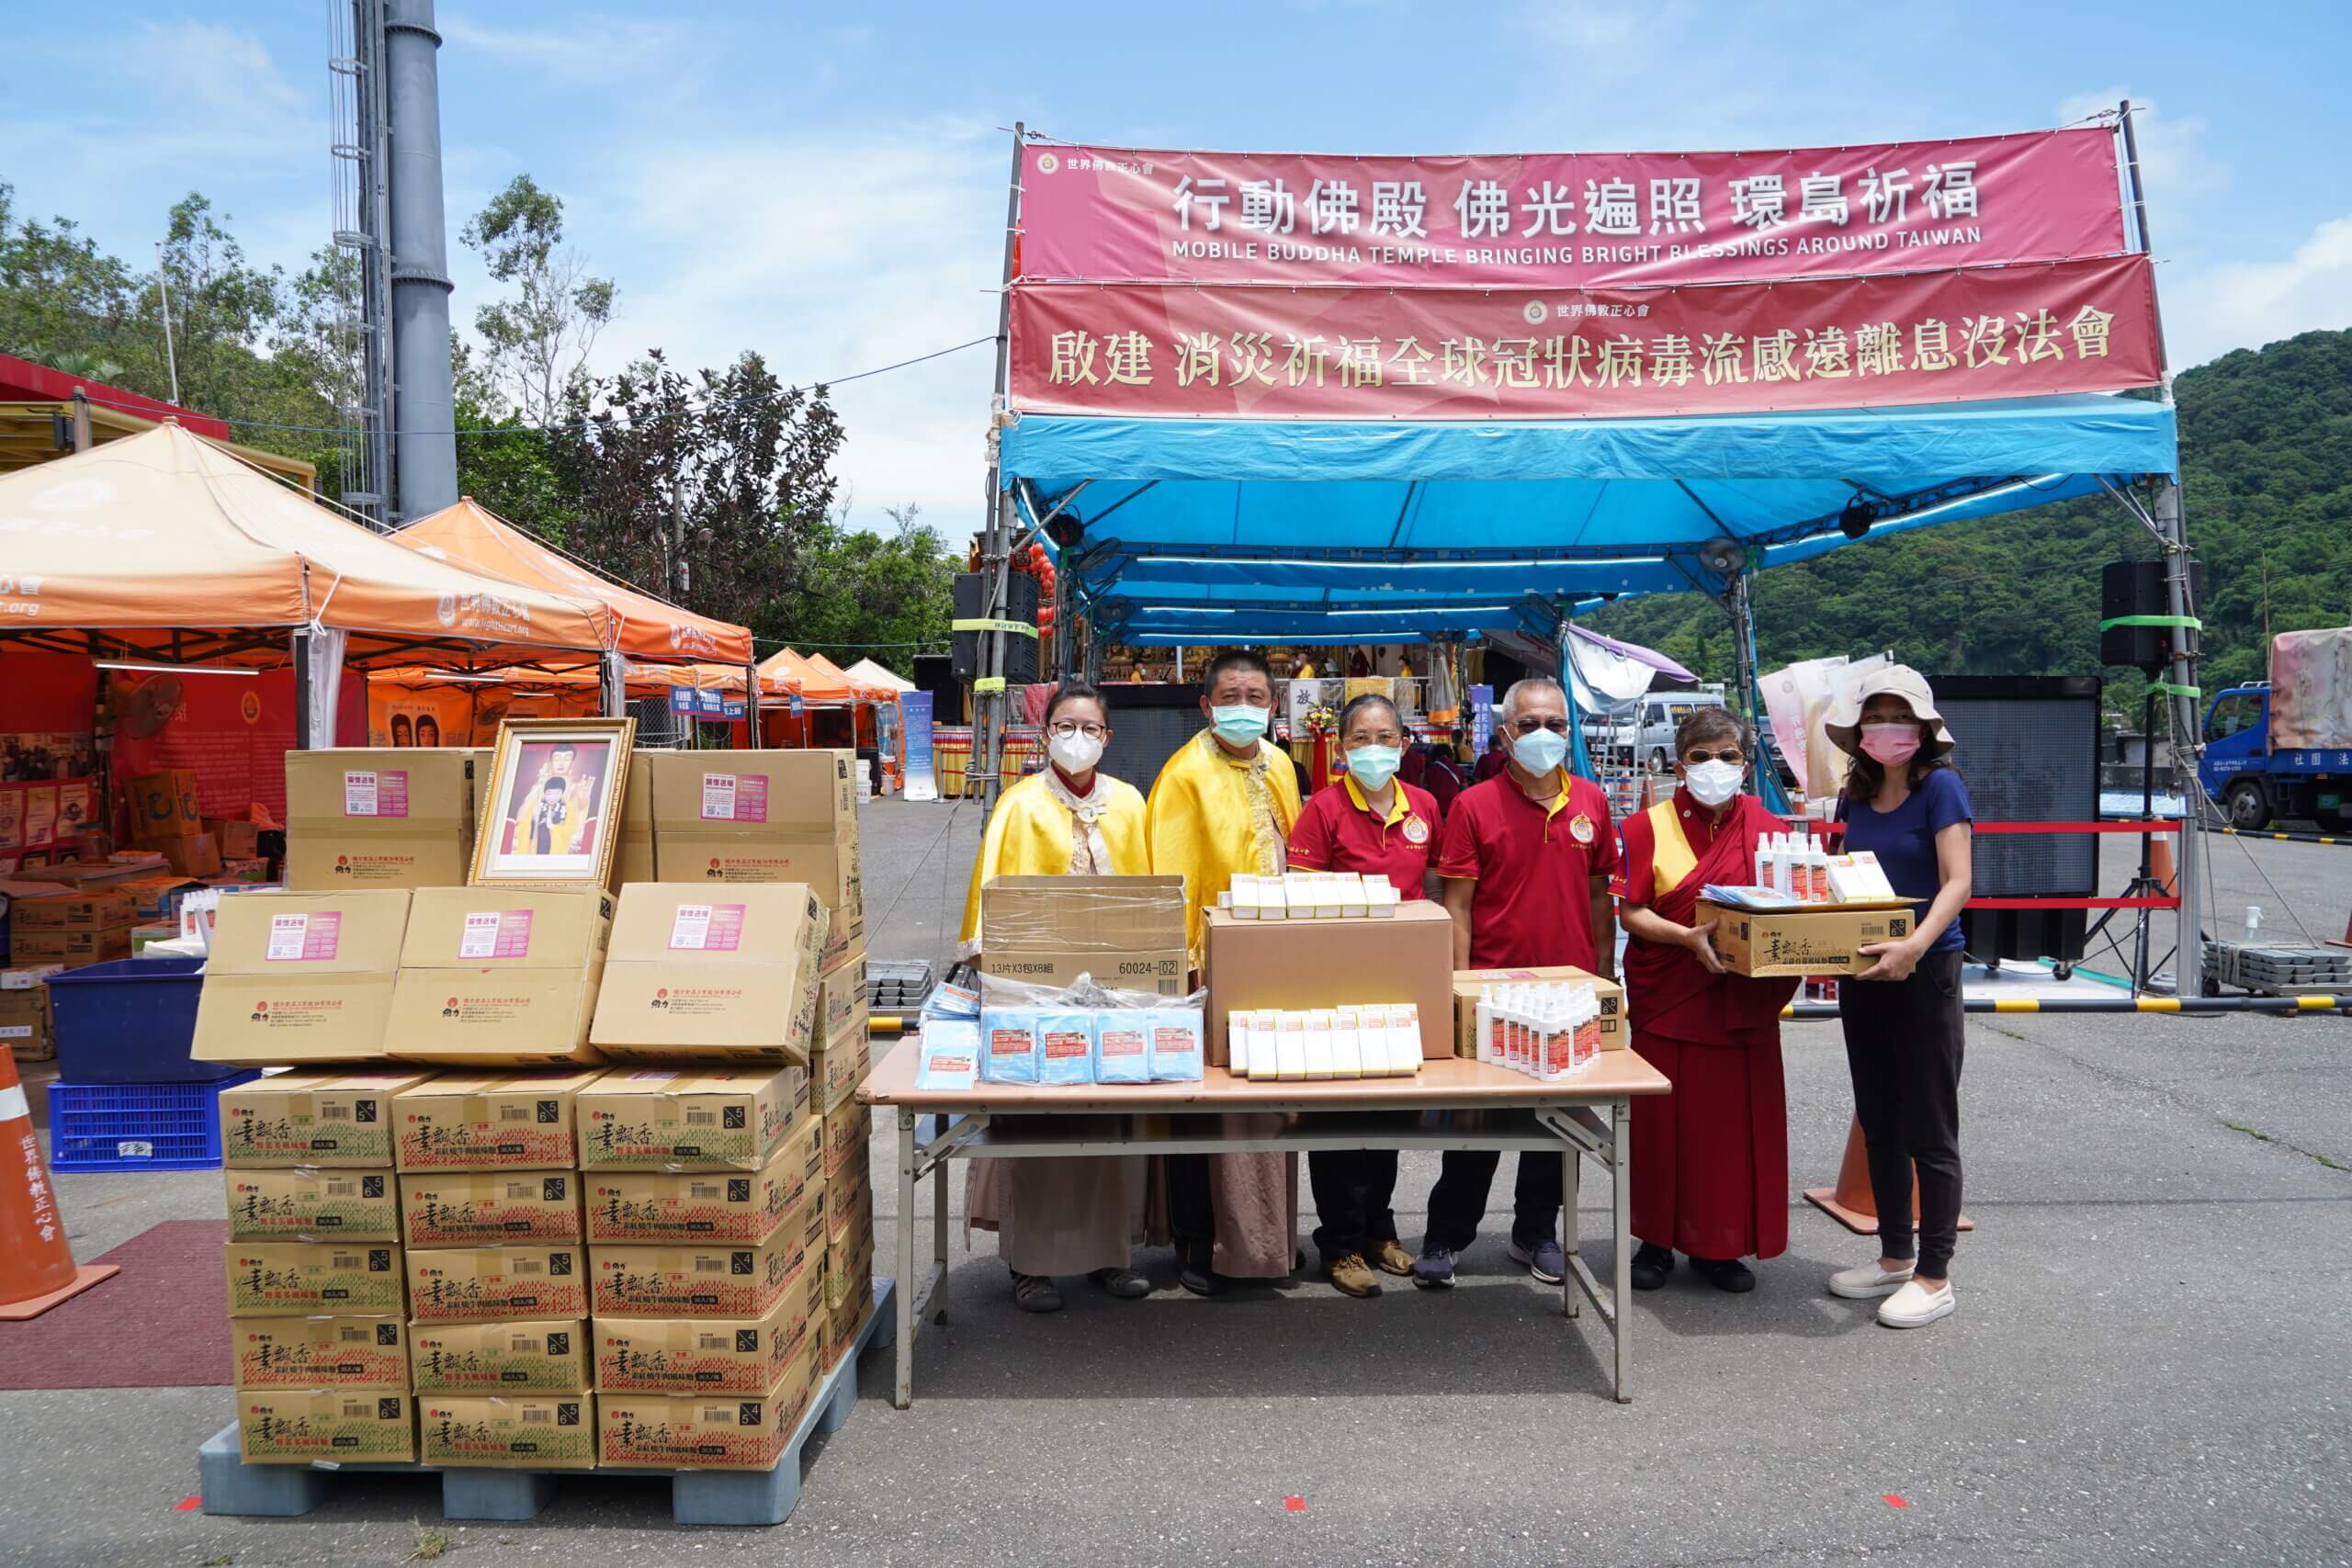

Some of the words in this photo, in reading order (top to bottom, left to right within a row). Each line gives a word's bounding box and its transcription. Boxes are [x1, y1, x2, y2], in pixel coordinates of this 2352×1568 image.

[1172, 175, 1427, 239] 行動佛殿
[1453, 176, 1706, 240] 佛光遍照
[1728, 161, 1979, 232] 環島祈福
[1172, 241, 1257, 260] MOBILE
[1267, 243, 1361, 264] BUDDHA
[1369, 246, 1457, 265] TEMPLE
[1466, 246, 1572, 266] BRINGING
[1582, 244, 1661, 265] BRIGHT
[1670, 237, 1789, 262] BLESSINGS
[1797, 231, 1889, 255] AROUND
[1897, 226, 1981, 248] TAIWAN
[1048, 330, 1155, 388] 啟建
[1898, 920, 1905, 929] 5
[1891, 928, 1897, 936] 6
[1119, 962, 1177, 975] 60024-02
[1611, 998, 1616, 1007] 5
[1602, 1006, 1609, 1014] 6
[368, 1102, 374, 1111] 4
[550, 1103, 557, 1112] 5
[358, 1111, 365, 1121] 5
[539, 1112, 546, 1122] 6
[736, 1108, 742, 1118] 5
[726, 1118, 733, 1127] 6
[375, 1178, 382, 1187] 5
[556, 1179, 563, 1190] 5
[741, 1181, 748, 1190] 5
[18, 1134, 56, 1243] 世界佛教正心會
[365, 1188, 371, 1197] 6
[546, 1190, 552, 1199] 6
[729, 1190, 737, 1201] 6
[381, 1251, 389, 1260] 5
[562, 1255, 569, 1265] 5
[743, 1254, 751, 1263] 4
[371, 1260, 379, 1270] 6
[552, 1265, 560, 1274] 6
[734, 1263, 741, 1273] 5
[389, 1325, 396, 1335] 5
[379, 1336, 387, 1344] 6
[560, 1335, 567, 1344] 5
[748, 1332, 754, 1341] 4
[549, 1344, 558, 1354] 6
[739, 1341, 745, 1350] 5
[391, 1399, 398, 1408] 5
[381, 1409, 389, 1418] 6
[570, 1405, 577, 1415] 5
[752, 1404, 759, 1414] 4
[560, 1415, 567, 1424] 6
[742, 1414, 749, 1424] 5
